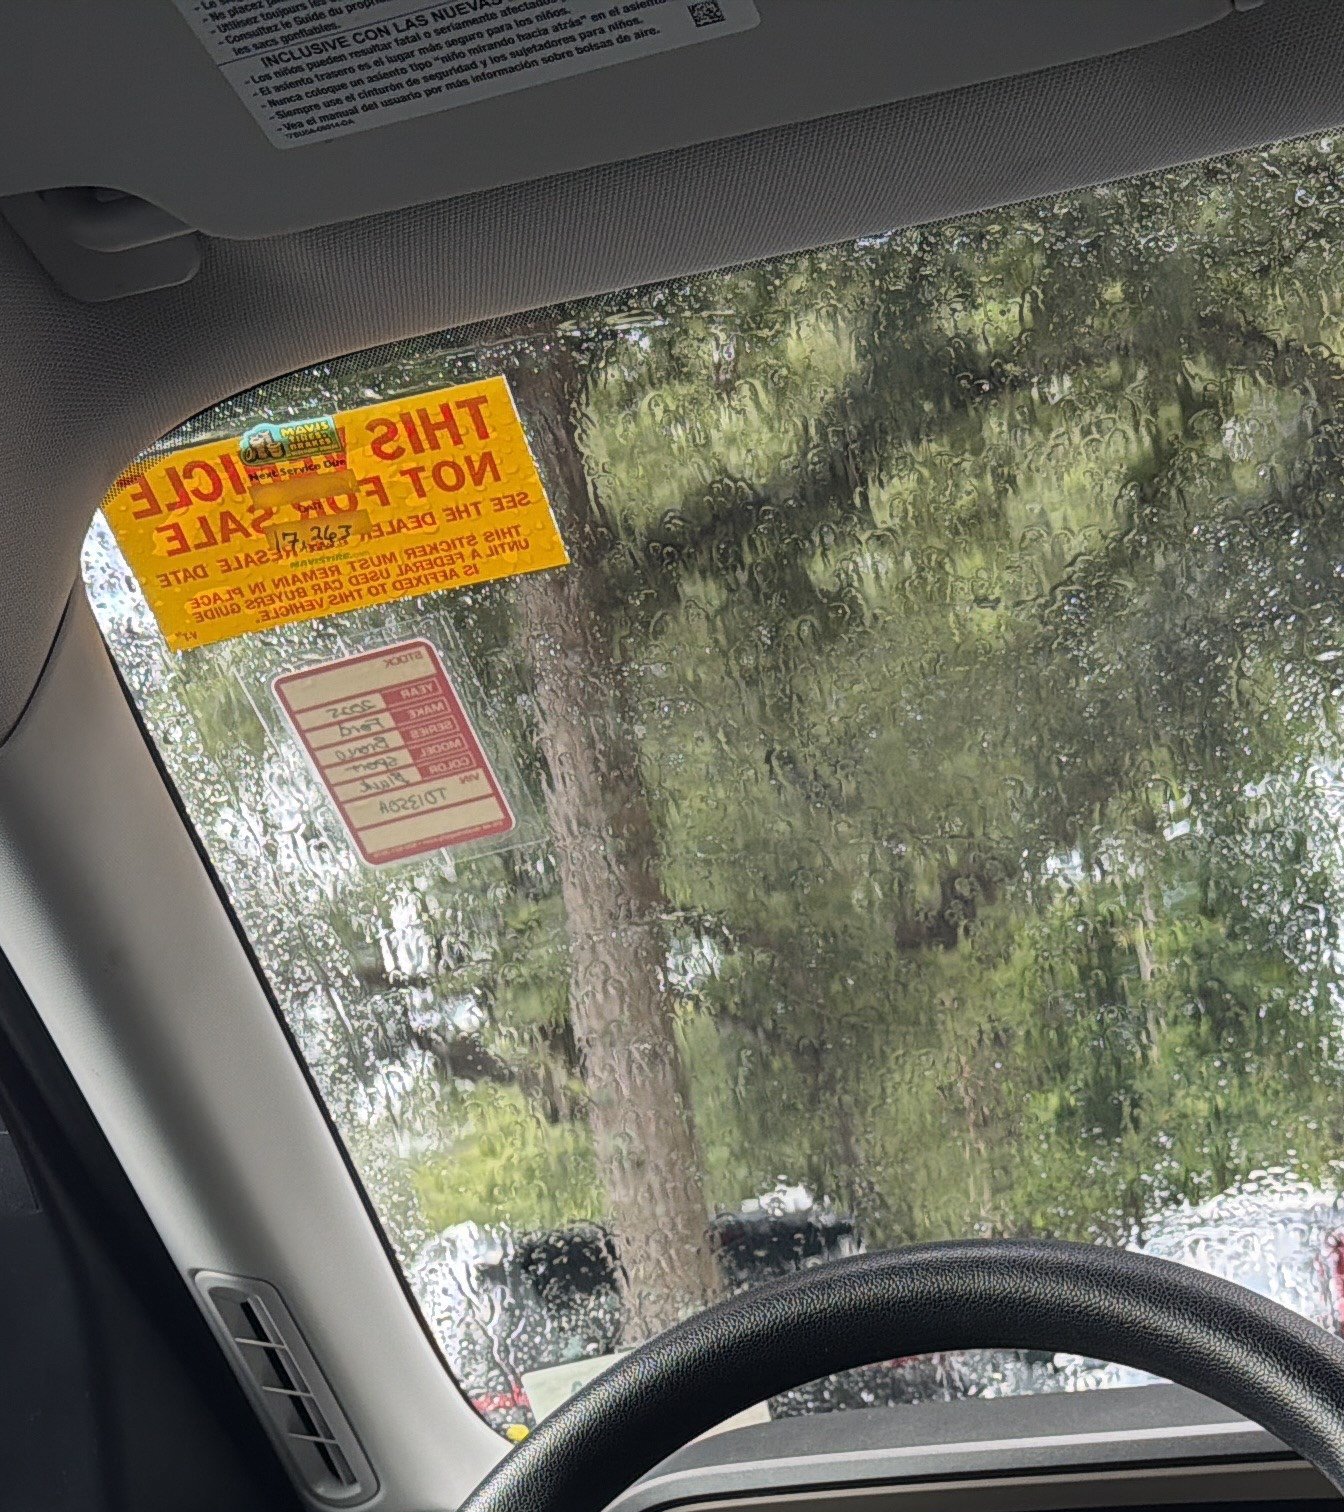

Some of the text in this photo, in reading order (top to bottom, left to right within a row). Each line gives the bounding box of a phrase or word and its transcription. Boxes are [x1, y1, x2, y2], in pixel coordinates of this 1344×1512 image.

[232, 46, 251, 56] les
[252, 39, 279, 50] sacs
[250, 73, 272, 84] Los
[306, 54, 347, 72] pueden
[348, 42, 392, 58] resultar
[394, 32, 421, 46] fatal
[433, 12, 498, 36] seriamente
[259, 86, 272, 96] El
[272, 77, 314, 92] asiento
[314, 66, 355, 82] trasero
[357, 62, 372, 71] es
[373, 57, 384, 67] el
[385, 50, 415, 64] lugar
[418, 43, 443, 55] más
[445, 32, 483, 48] seguro
[485, 23, 513, 38] para
[514, 17, 533, 28] los
[261, 36, 351, 68] INCLUSIVE
[353, 25, 391, 44] CON
[392, 15, 428, 33] LAS
[267, 94, 303, 107] Nunca
[305, 83, 348, 98] coloque
[349, 78, 365, 88] un
[367, 67, 408, 83] asiento
[409, 61, 433, 72] tipo
[467, 37, 515, 56] mirando
[516, 28, 549, 42] hacia
[591, 12, 606, 22] en
[609, 6, 620, 17] el
[275, 104, 321, 119] Siempre
[322, 98, 343, 108] use
[345, 93, 356, 102] el
[358, 83, 404, 99] cinturón
[405, 78, 420, 87] de
[421, 61, 478, 82] seguridad
[488, 54, 507, 64] los
[509, 35, 576, 58] sujetadores
[578, 27, 606, 42] para
[282, 122, 304, 130] Vea
[306, 116, 317, 125] el
[318, 106, 359, 122] manual
[361, 102, 379, 112] del
[380, 92, 422, 107] usuario
[423, 86, 442, 97] por
[445, 79, 470, 90] más
[471, 59, 539, 83] información
[541, 50, 574, 64] sobre
[575, 39, 614, 54] bolsas
[616, 35, 631, 44] de
[634, 28, 660, 39] aire.
[281, 421, 329, 437] MAVIS
[249, 459, 347, 480] Next Service Due
